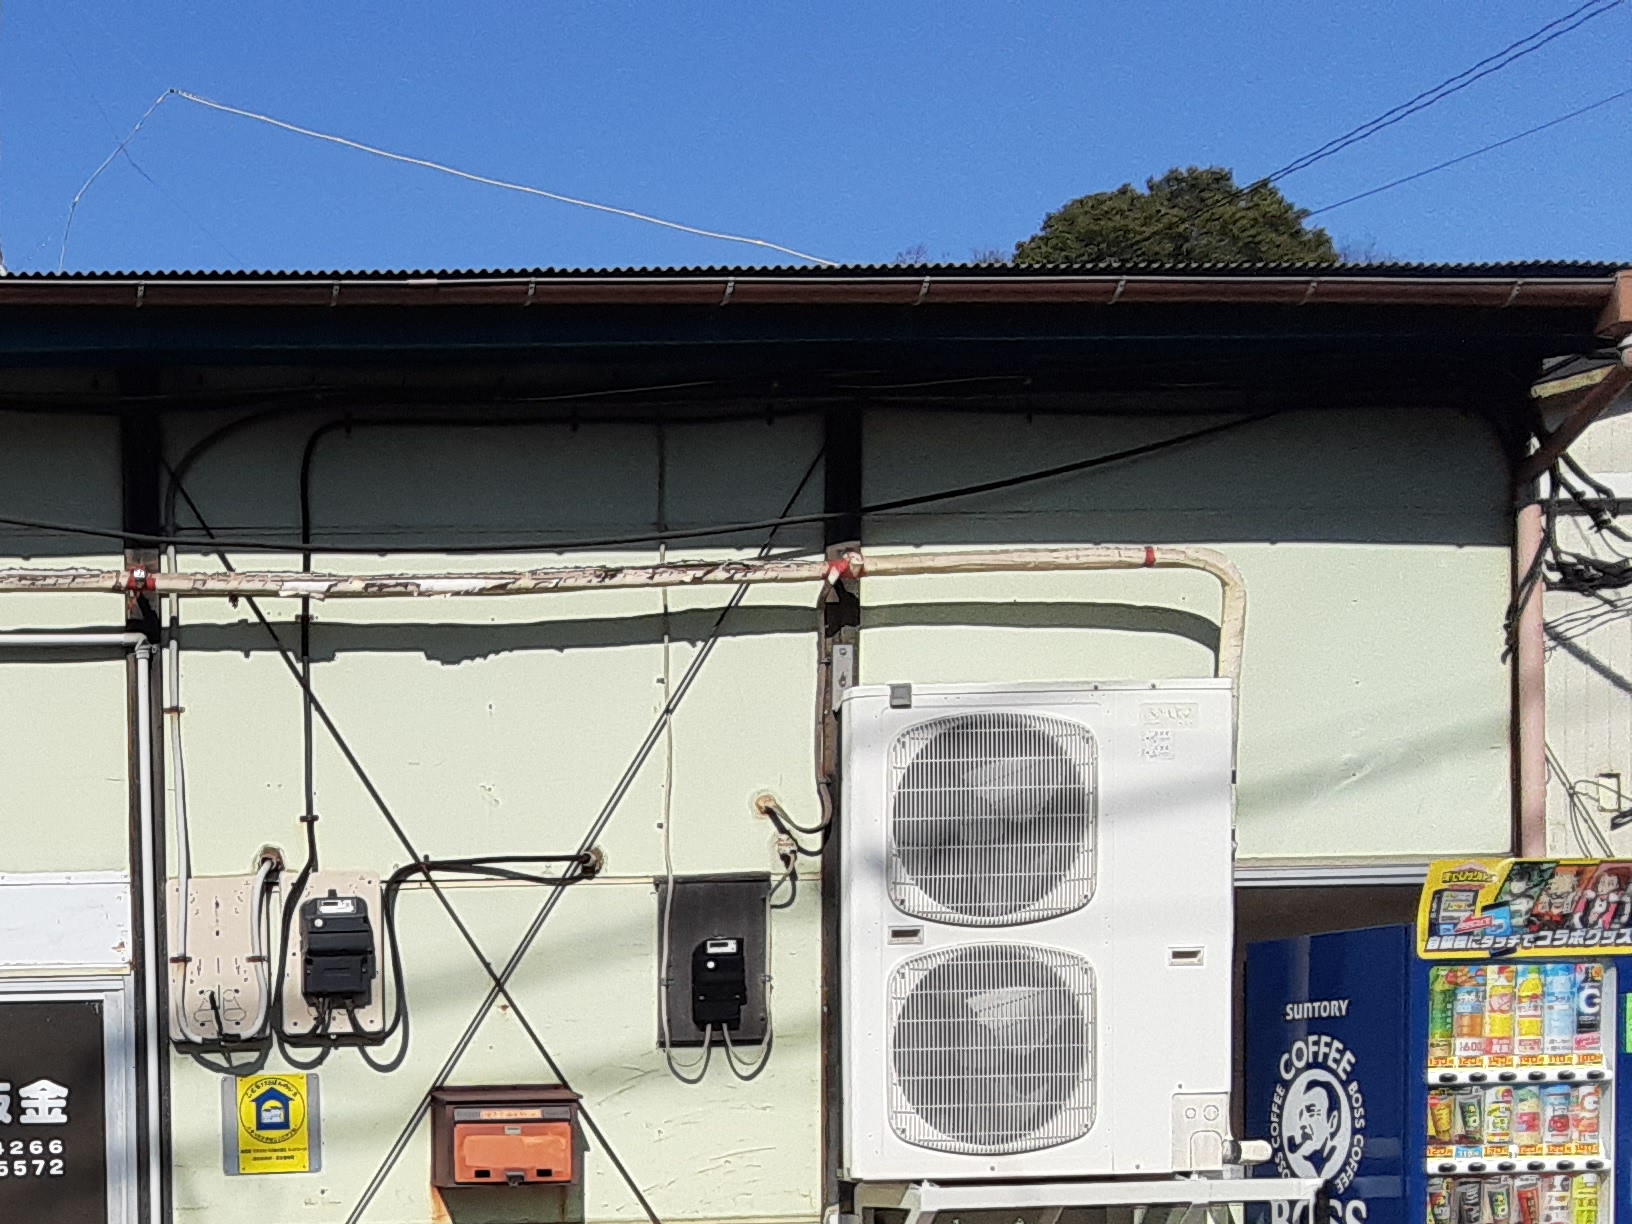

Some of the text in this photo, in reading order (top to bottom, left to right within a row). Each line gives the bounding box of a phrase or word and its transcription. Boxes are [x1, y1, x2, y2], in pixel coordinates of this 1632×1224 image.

[1286, 1000, 1349, 1020] SUNTORY
[1280, 1034, 1356, 1081] COFFEE
[1270, 1083, 1285, 1148] COFFEE
[1334, 1081, 1365, 1194] BOSS COFFEE
